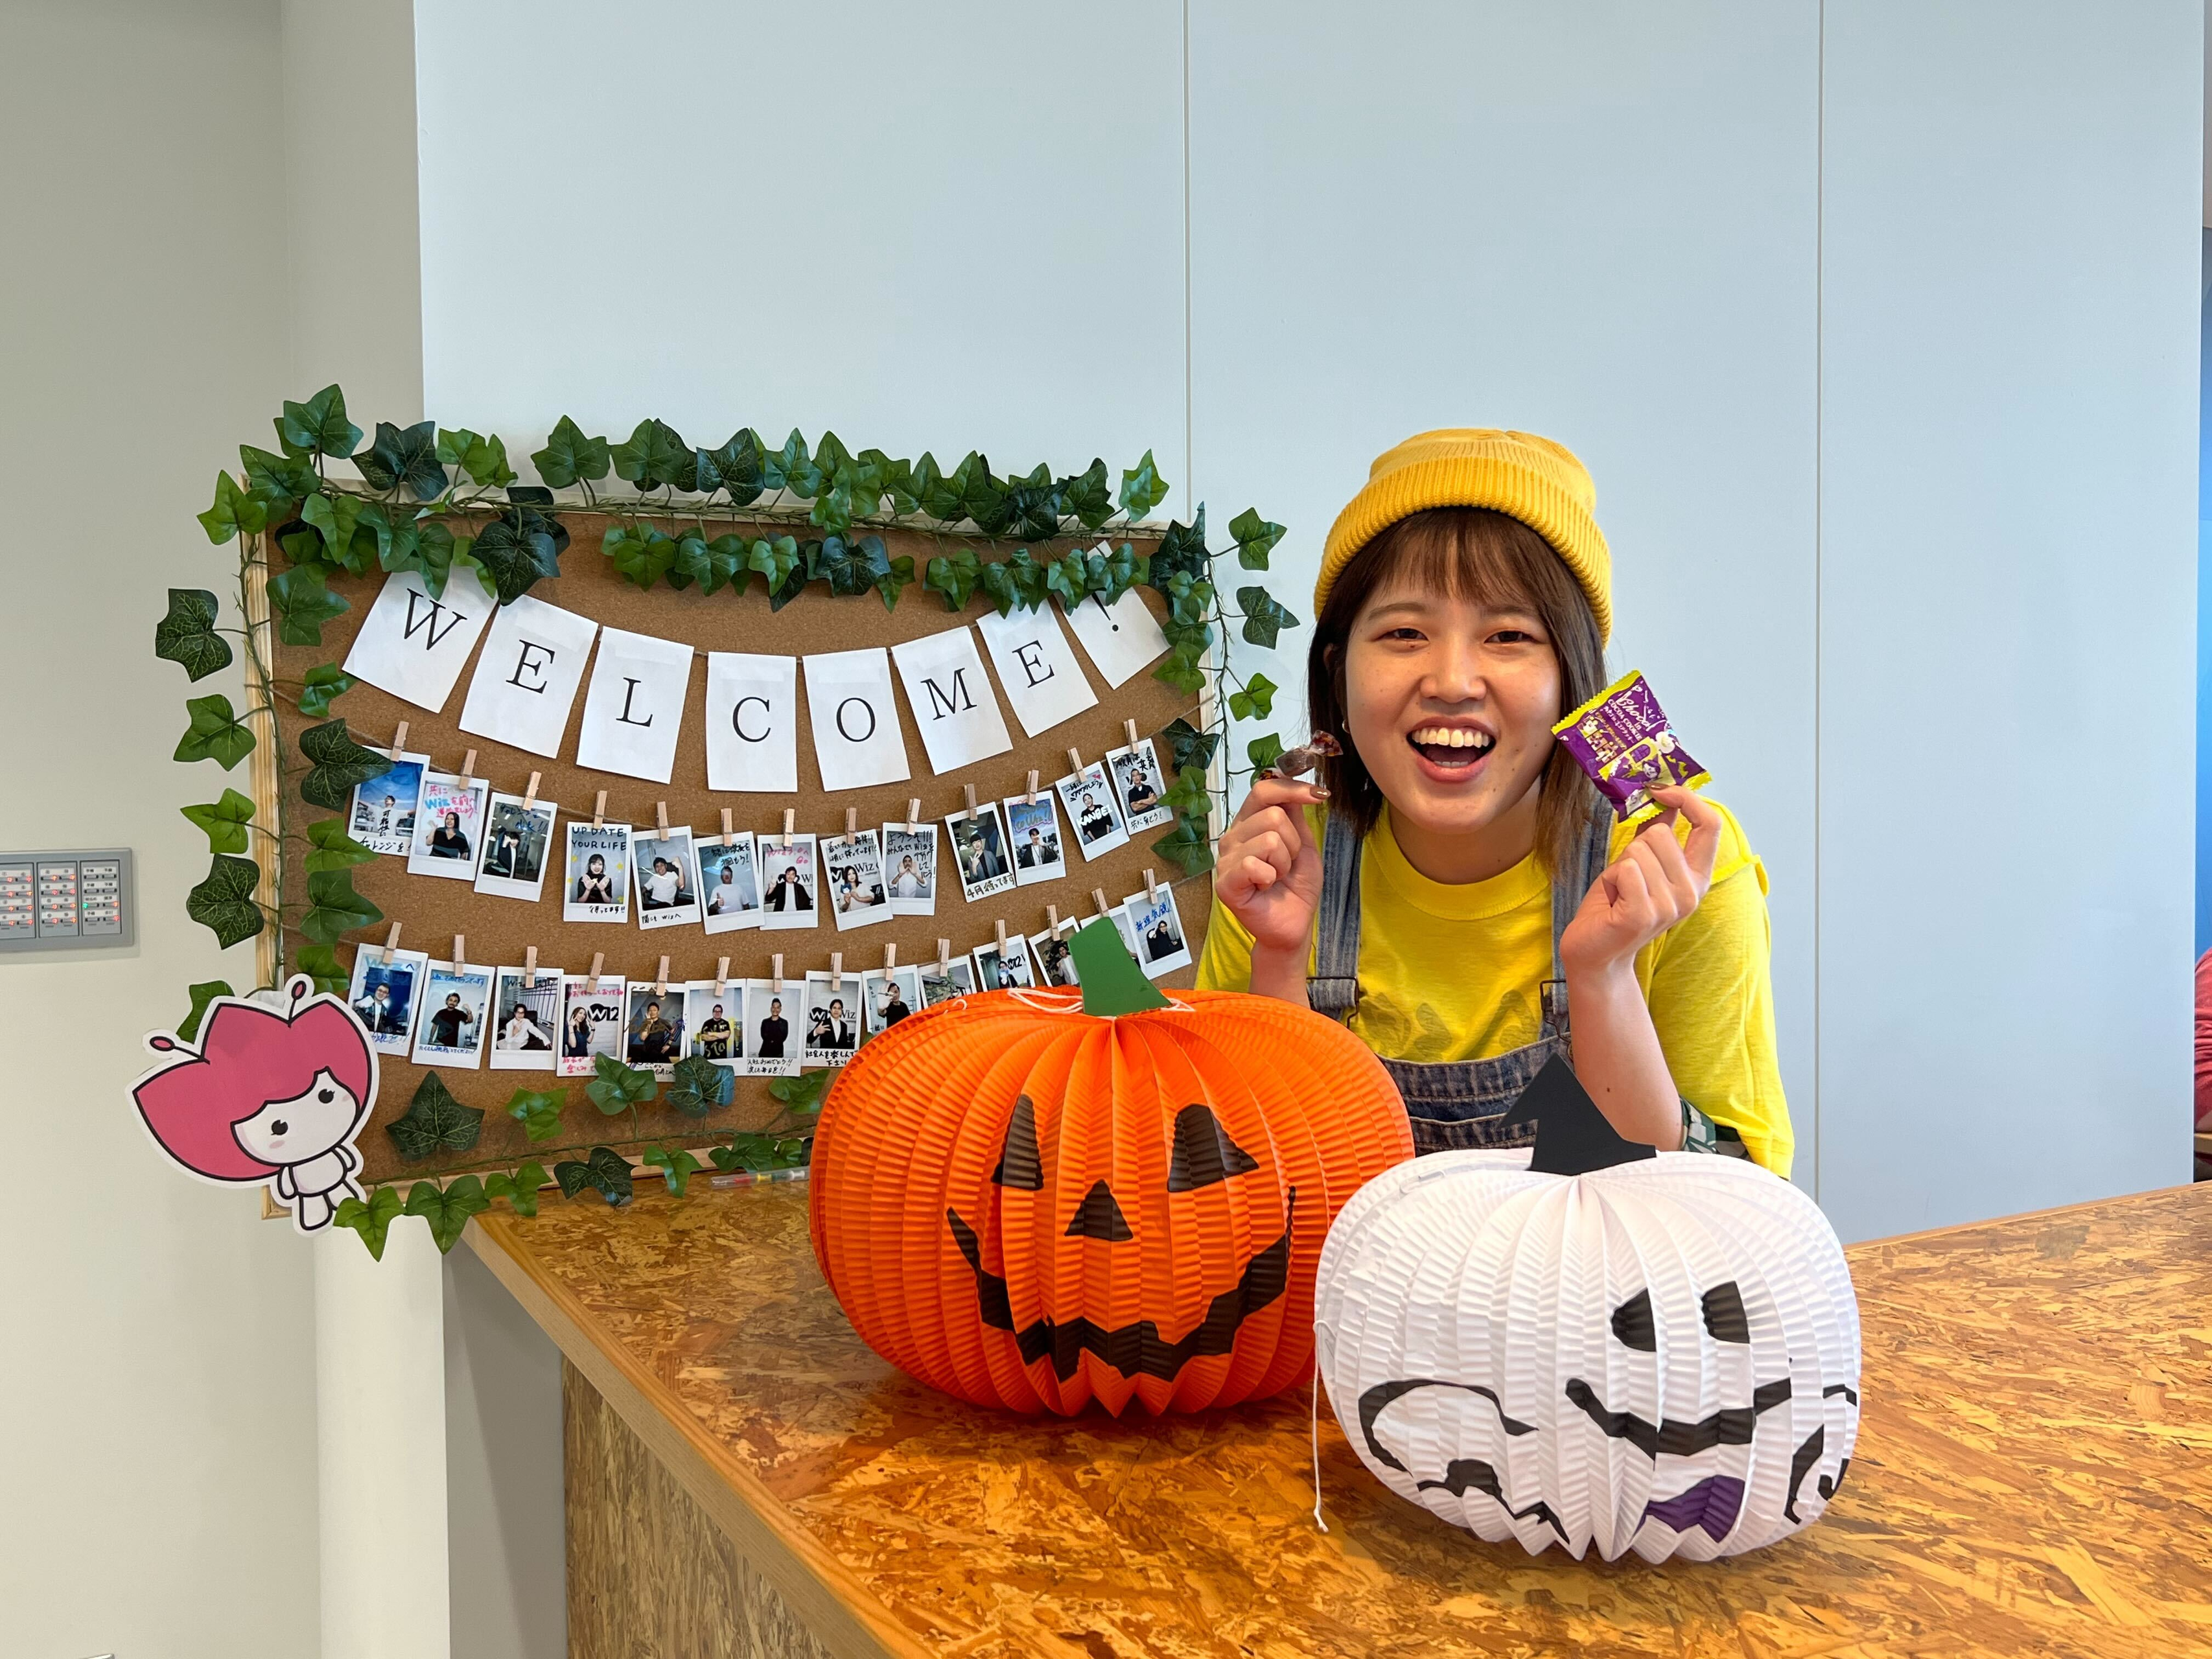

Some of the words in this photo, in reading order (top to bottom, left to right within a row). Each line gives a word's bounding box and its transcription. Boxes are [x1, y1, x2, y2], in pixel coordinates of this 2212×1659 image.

[1607, 699, 1625, 719] COCOA
[1623, 718, 1643, 741] COOKIE
[428, 785, 448, 796] 共に
[571, 840, 598, 848] YOUR
[601, 841, 627, 851] LIFE
[854, 863, 875, 873] Wiz
